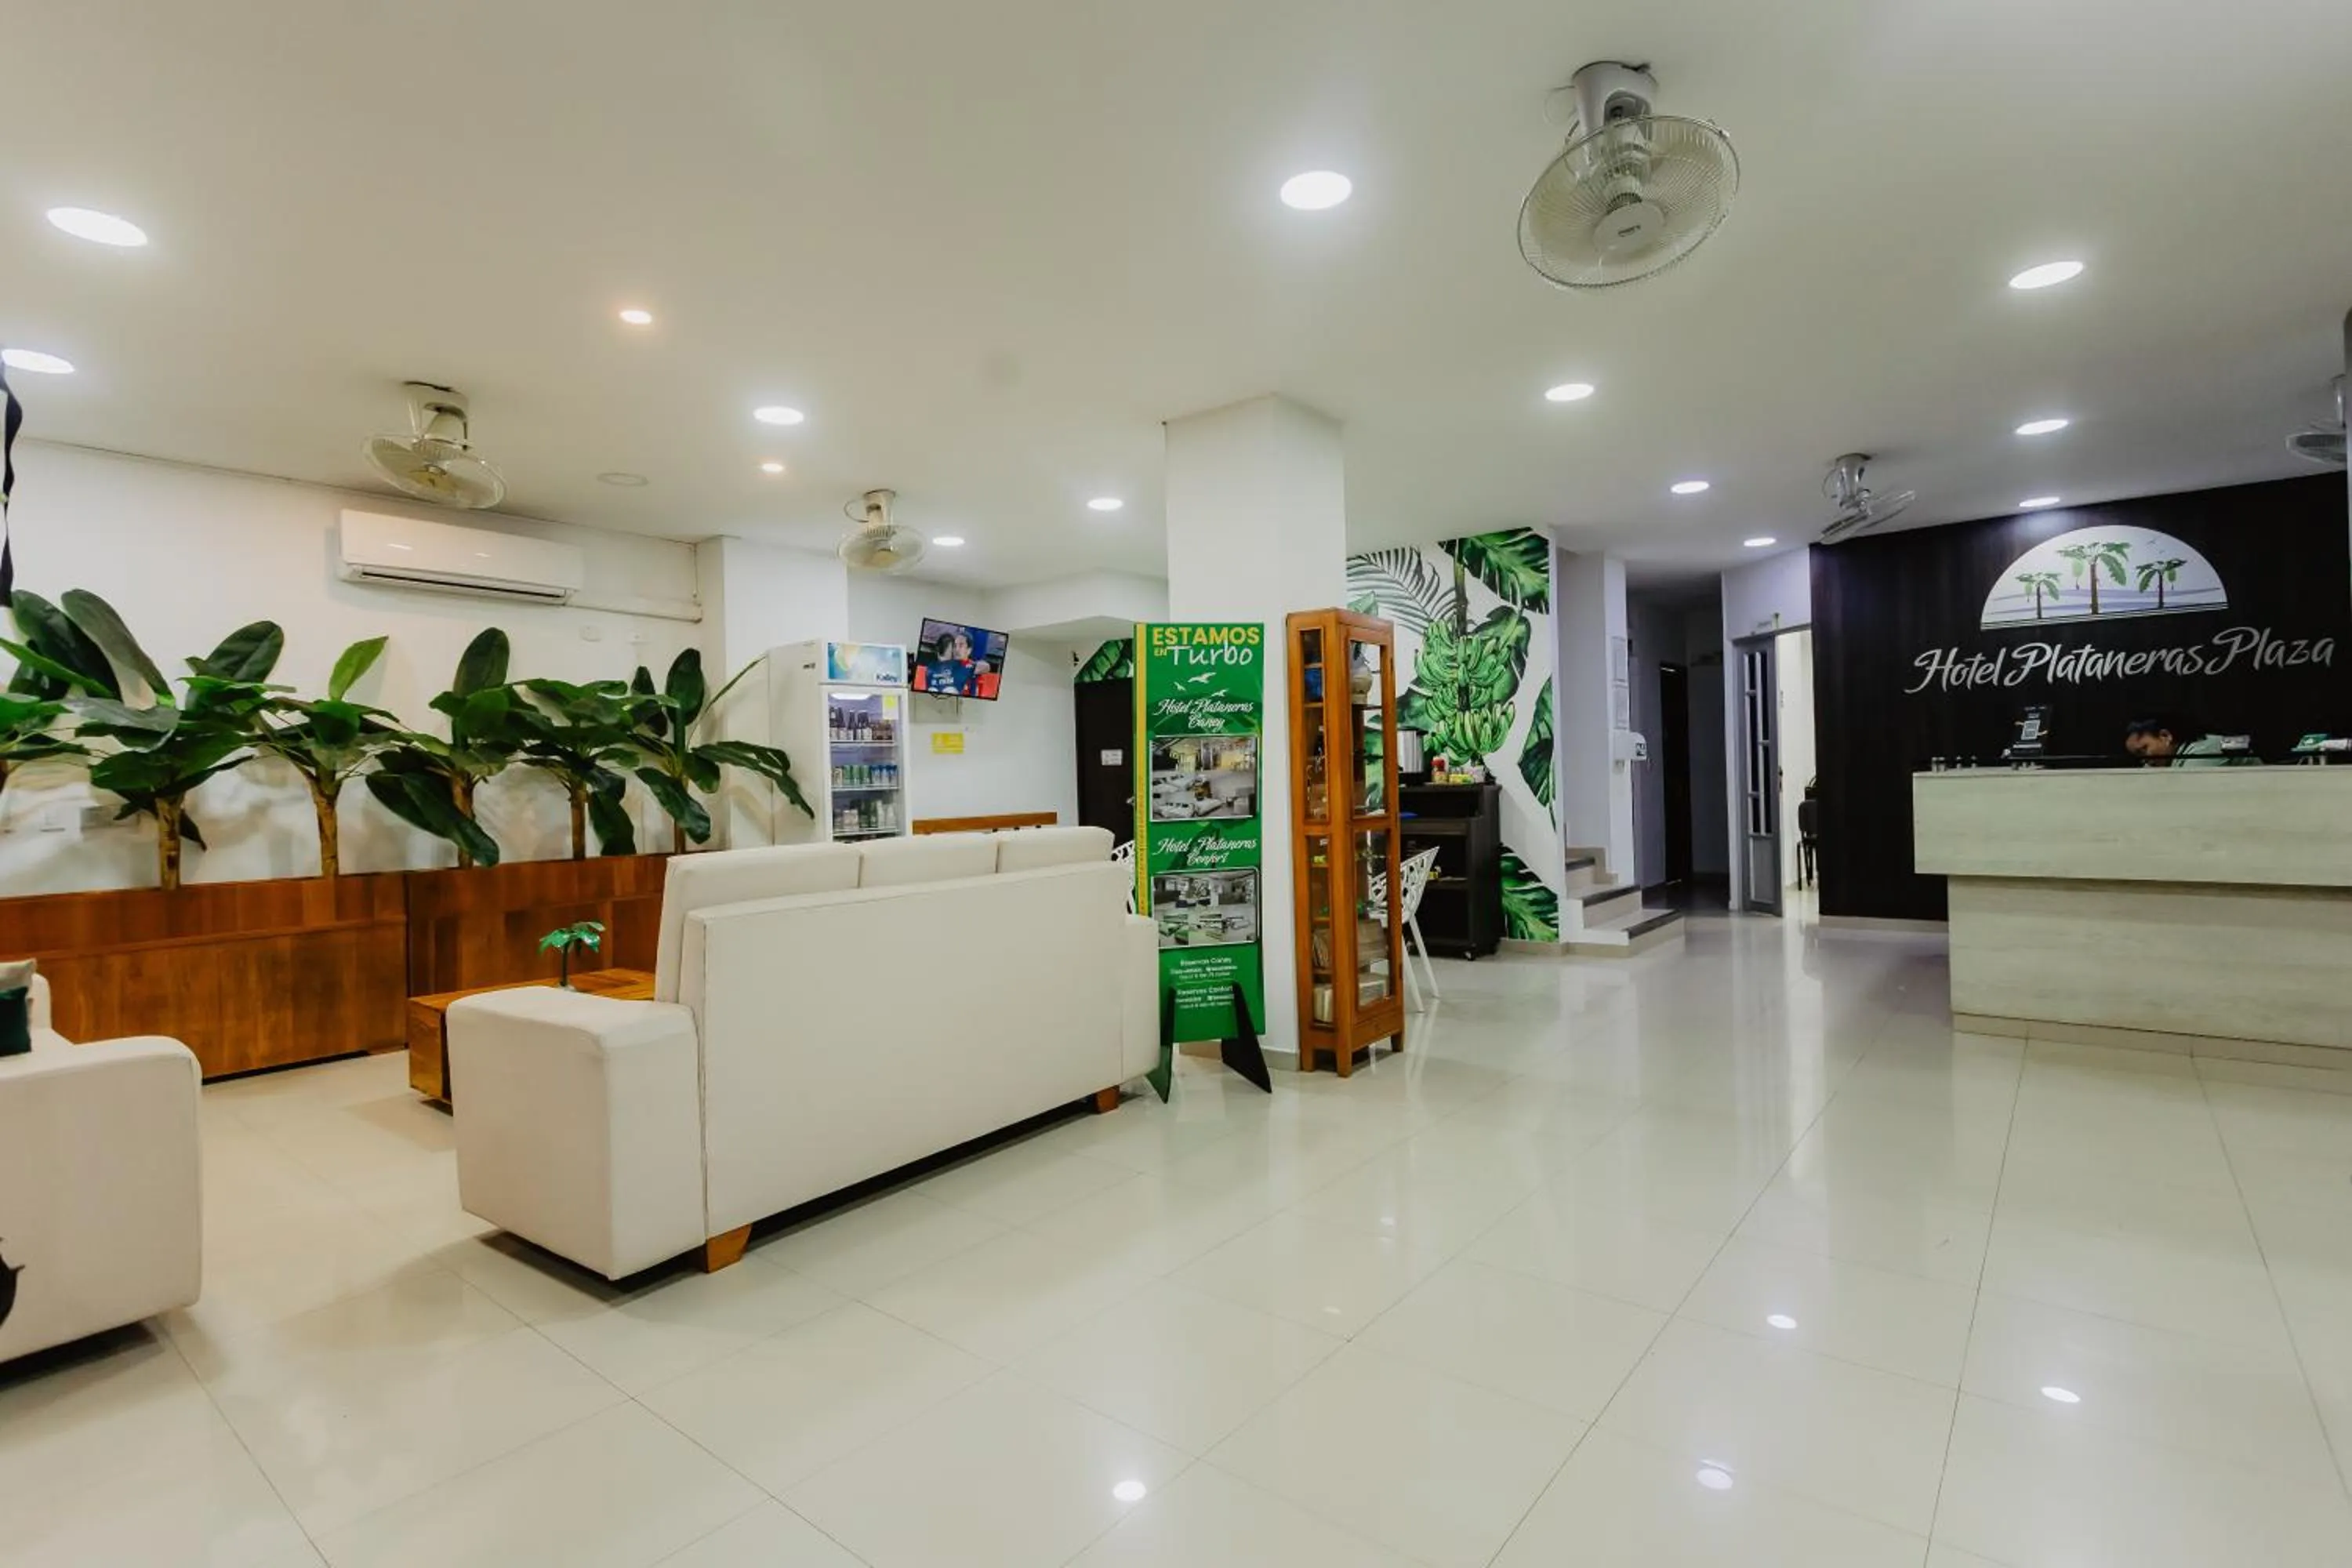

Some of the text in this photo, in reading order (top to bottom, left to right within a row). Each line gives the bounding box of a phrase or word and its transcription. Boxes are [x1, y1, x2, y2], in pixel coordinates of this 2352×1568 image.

[1152, 626, 1260, 645] ESTAMOS
[1153, 640, 1254, 666] EN Turbo
[1904, 626, 2336, 694] Hotel Plataneras Plaza
[1152, 699, 1193, 716] Hotel
[1152, 837, 1192, 855] Hotel
